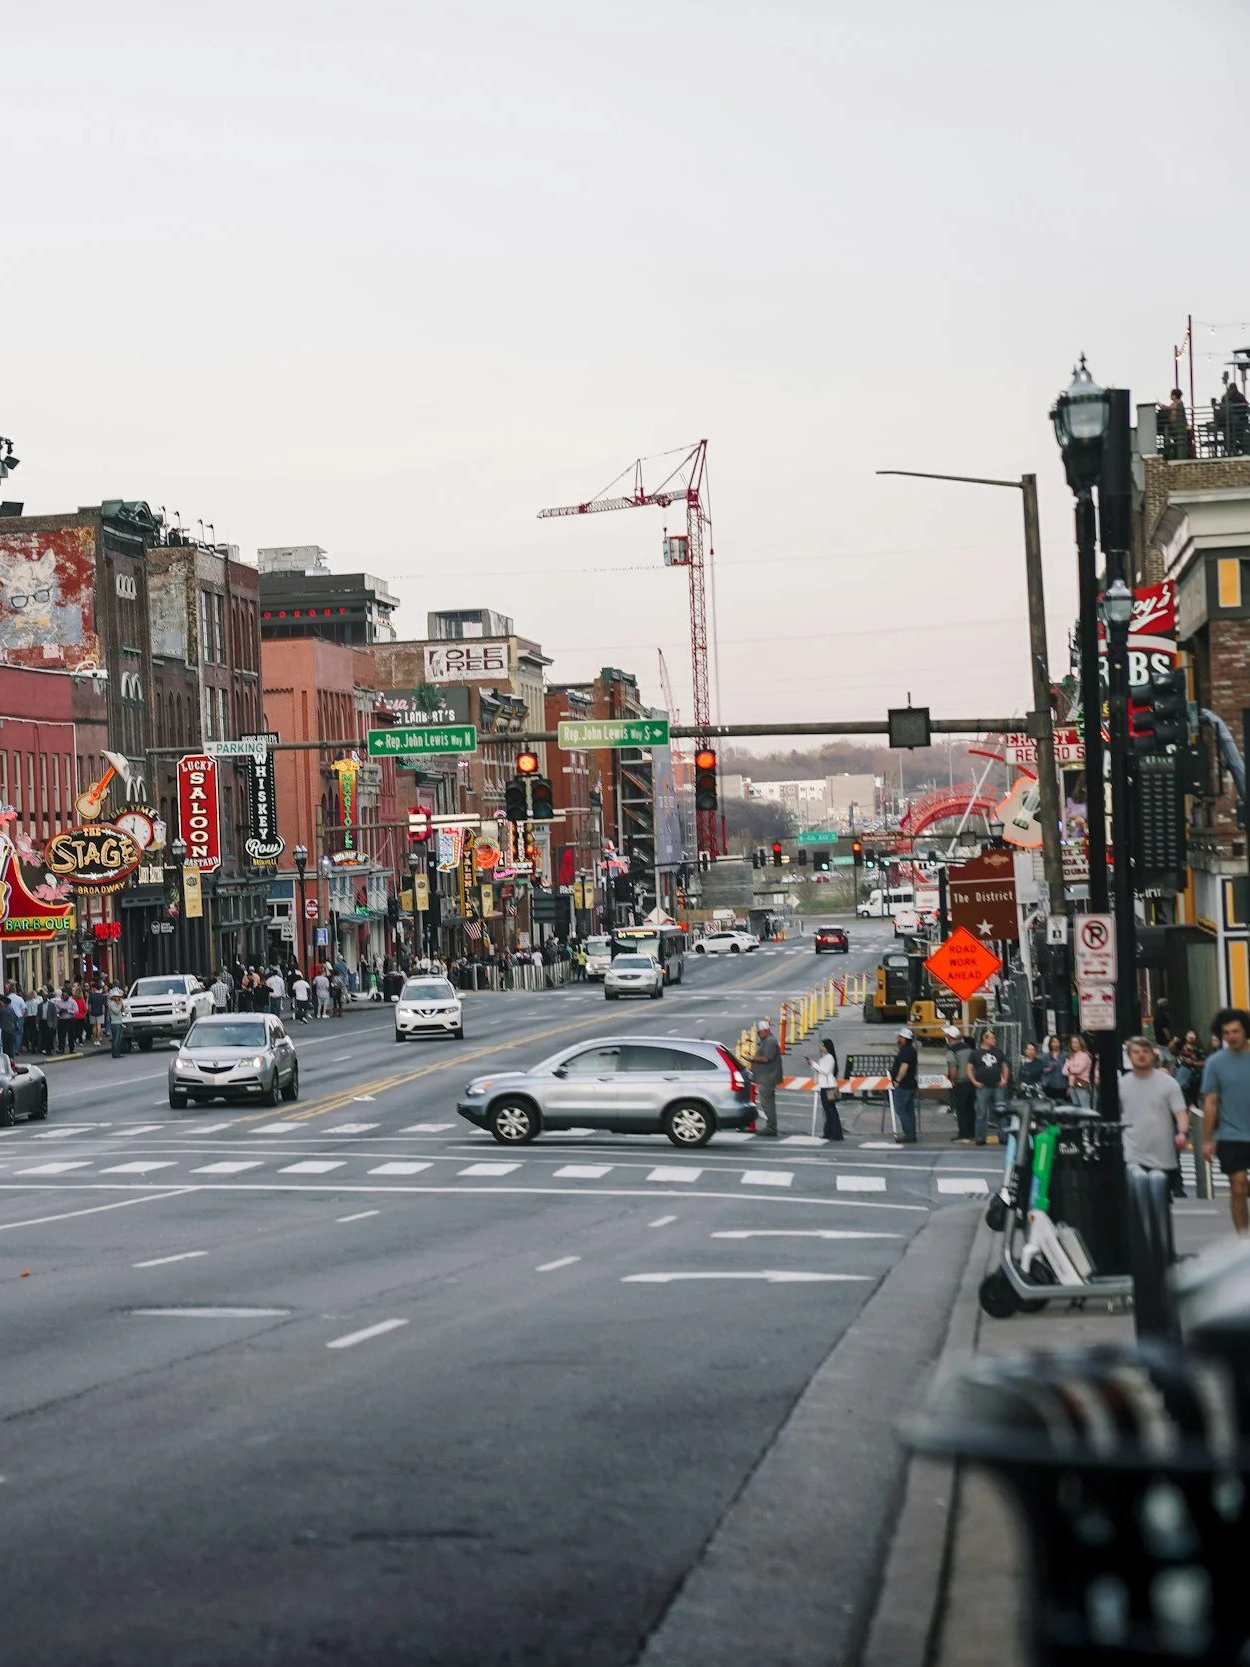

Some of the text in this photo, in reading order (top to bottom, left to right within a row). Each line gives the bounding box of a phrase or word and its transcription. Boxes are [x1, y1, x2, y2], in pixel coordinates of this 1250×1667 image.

[445, 647, 503, 660] OLE
[446, 660, 504, 671] RED
[1099, 651, 1170, 687] RBS
[385, 731, 471, 751] Rep. John Lewis Way N
[564, 725, 651, 744] Rep. John Lewis Way S
[1006, 730, 1070, 747] ERNST
[216, 743, 264, 754] PARKING
[1015, 747, 1070, 762] RECRD
[180, 760, 215, 773] LUCKY
[253, 753, 269, 840] WHISKEY
[130, 804, 156, 818] TIME
[189, 772, 209, 857] SALOON
[83, 828, 101, 837] THE
[51, 835, 138, 873] STAGE
[246, 838, 279, 858] Row
[184, 856, 219, 868] BASTARD
[77, 882, 126, 895] BROADWAY
[953, 890, 1014, 903] The District
[5, 917, 70, 931] BAR-B-QUE
[950, 945, 976, 954] ROAD
[950, 958, 977, 967] WORK
[948, 971, 982, 980] AHEAD
